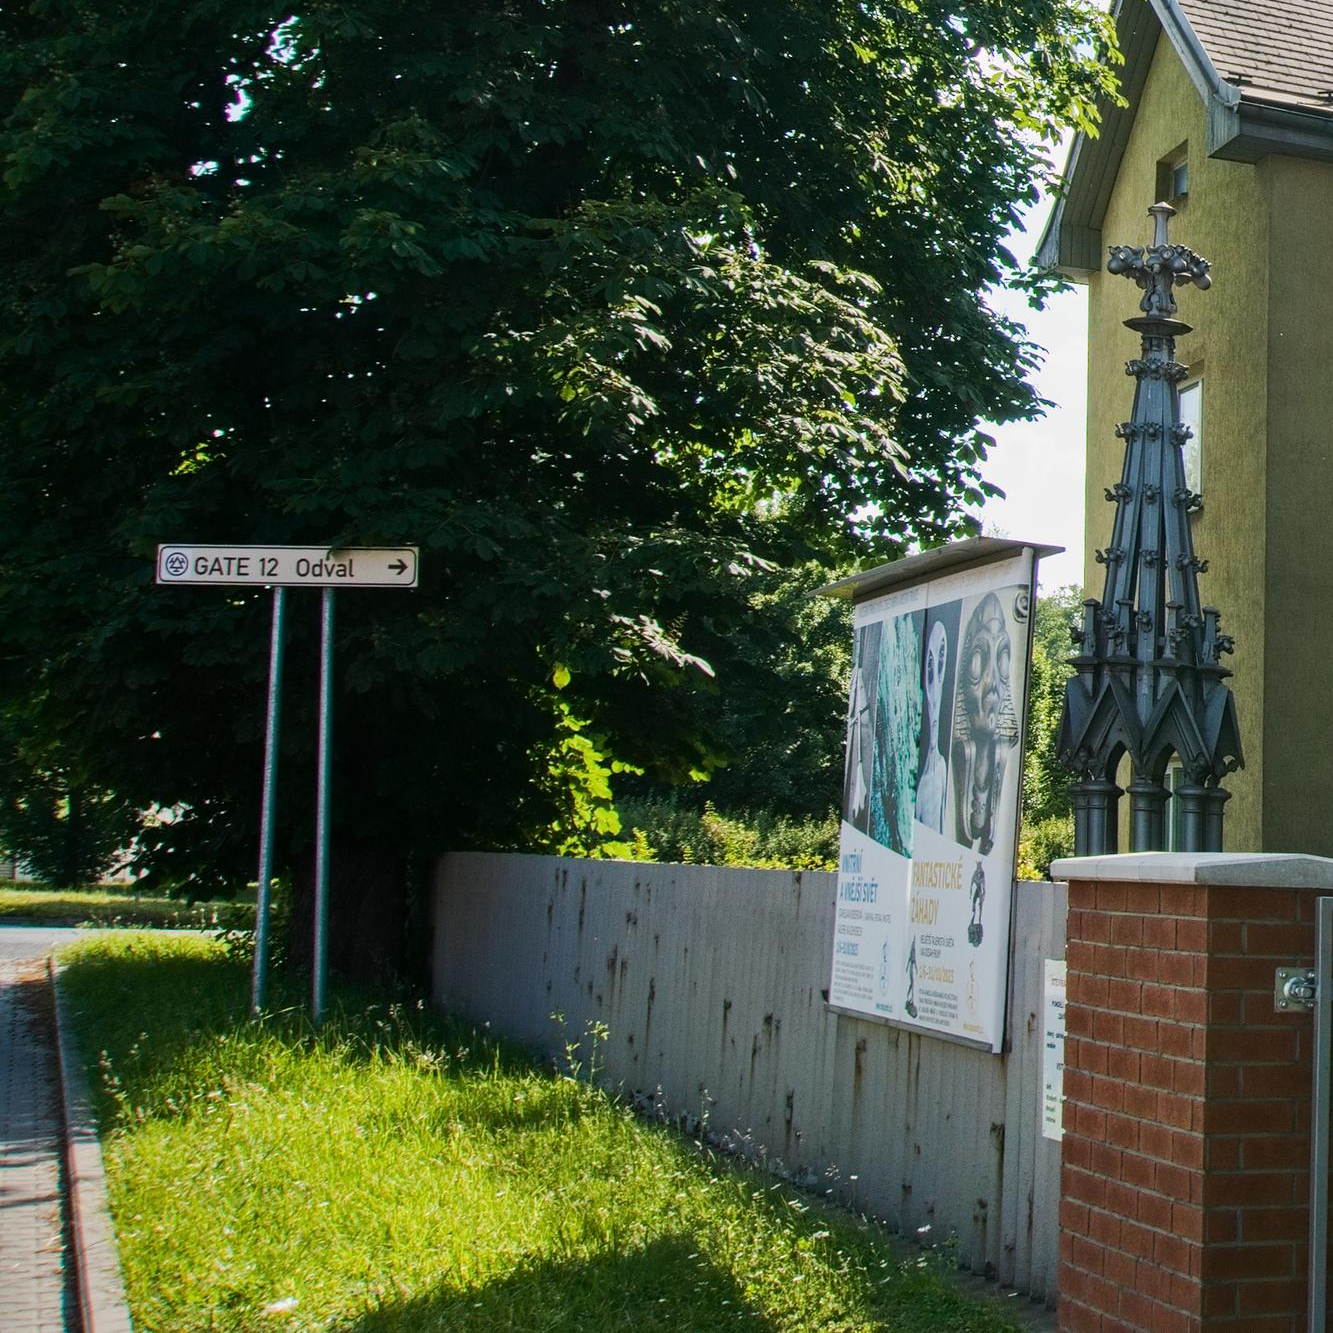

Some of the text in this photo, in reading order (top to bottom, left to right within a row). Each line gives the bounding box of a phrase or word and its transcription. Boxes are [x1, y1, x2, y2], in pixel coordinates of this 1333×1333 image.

[194, 556, 354, 578] GATE 12 Odval
[912, 854, 963, 890] FANTASTICKÉ
[863, 877, 879, 903] SVĚT
[911, 890, 940, 925] ZÁHADY
